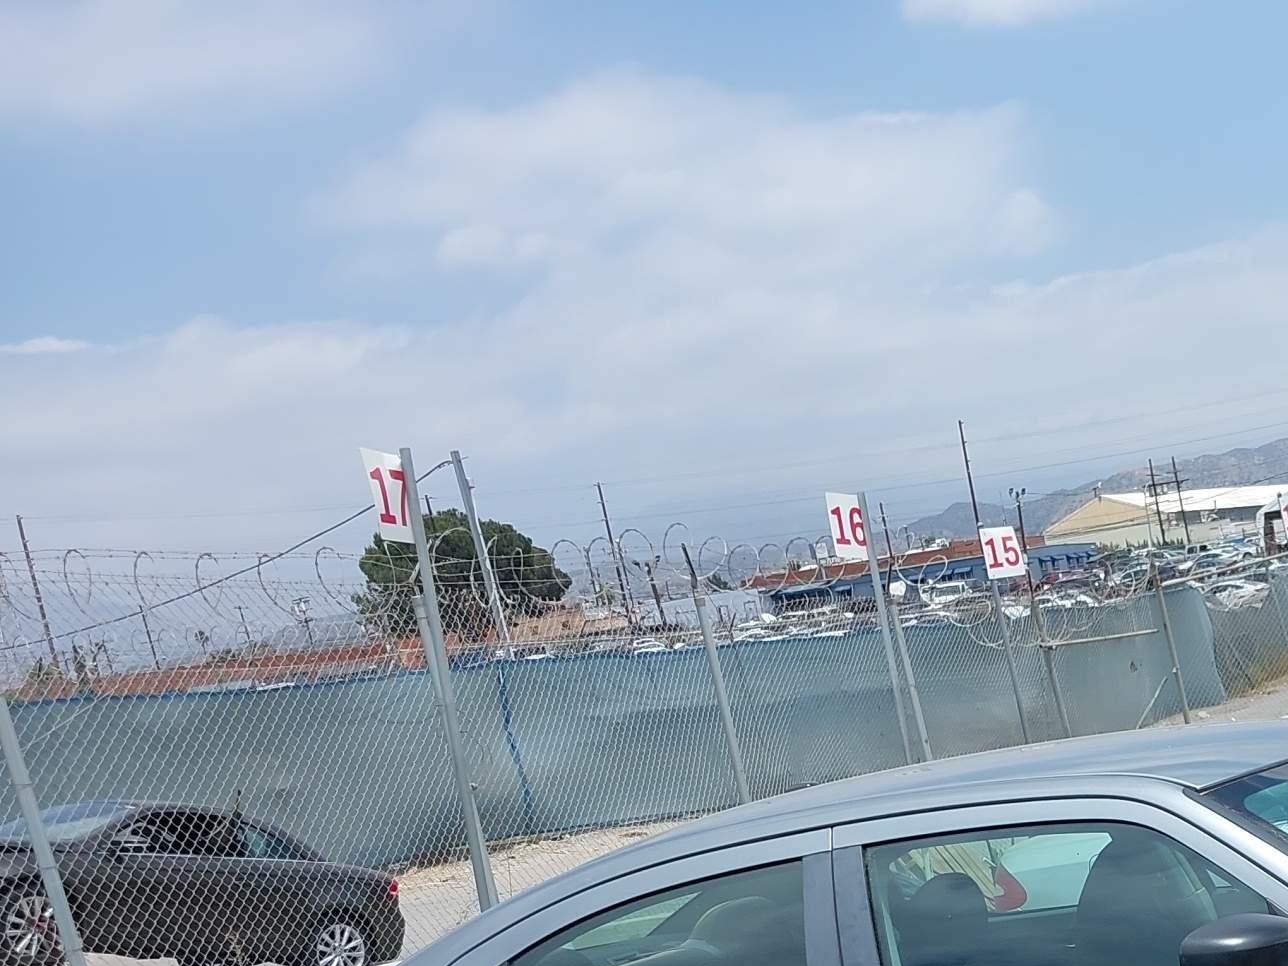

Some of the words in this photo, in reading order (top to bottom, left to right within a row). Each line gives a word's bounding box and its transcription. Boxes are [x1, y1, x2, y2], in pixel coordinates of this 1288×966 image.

[369, 467, 408, 527] 17
[831, 506, 867, 547] 16
[984, 536, 1020, 569] 15
